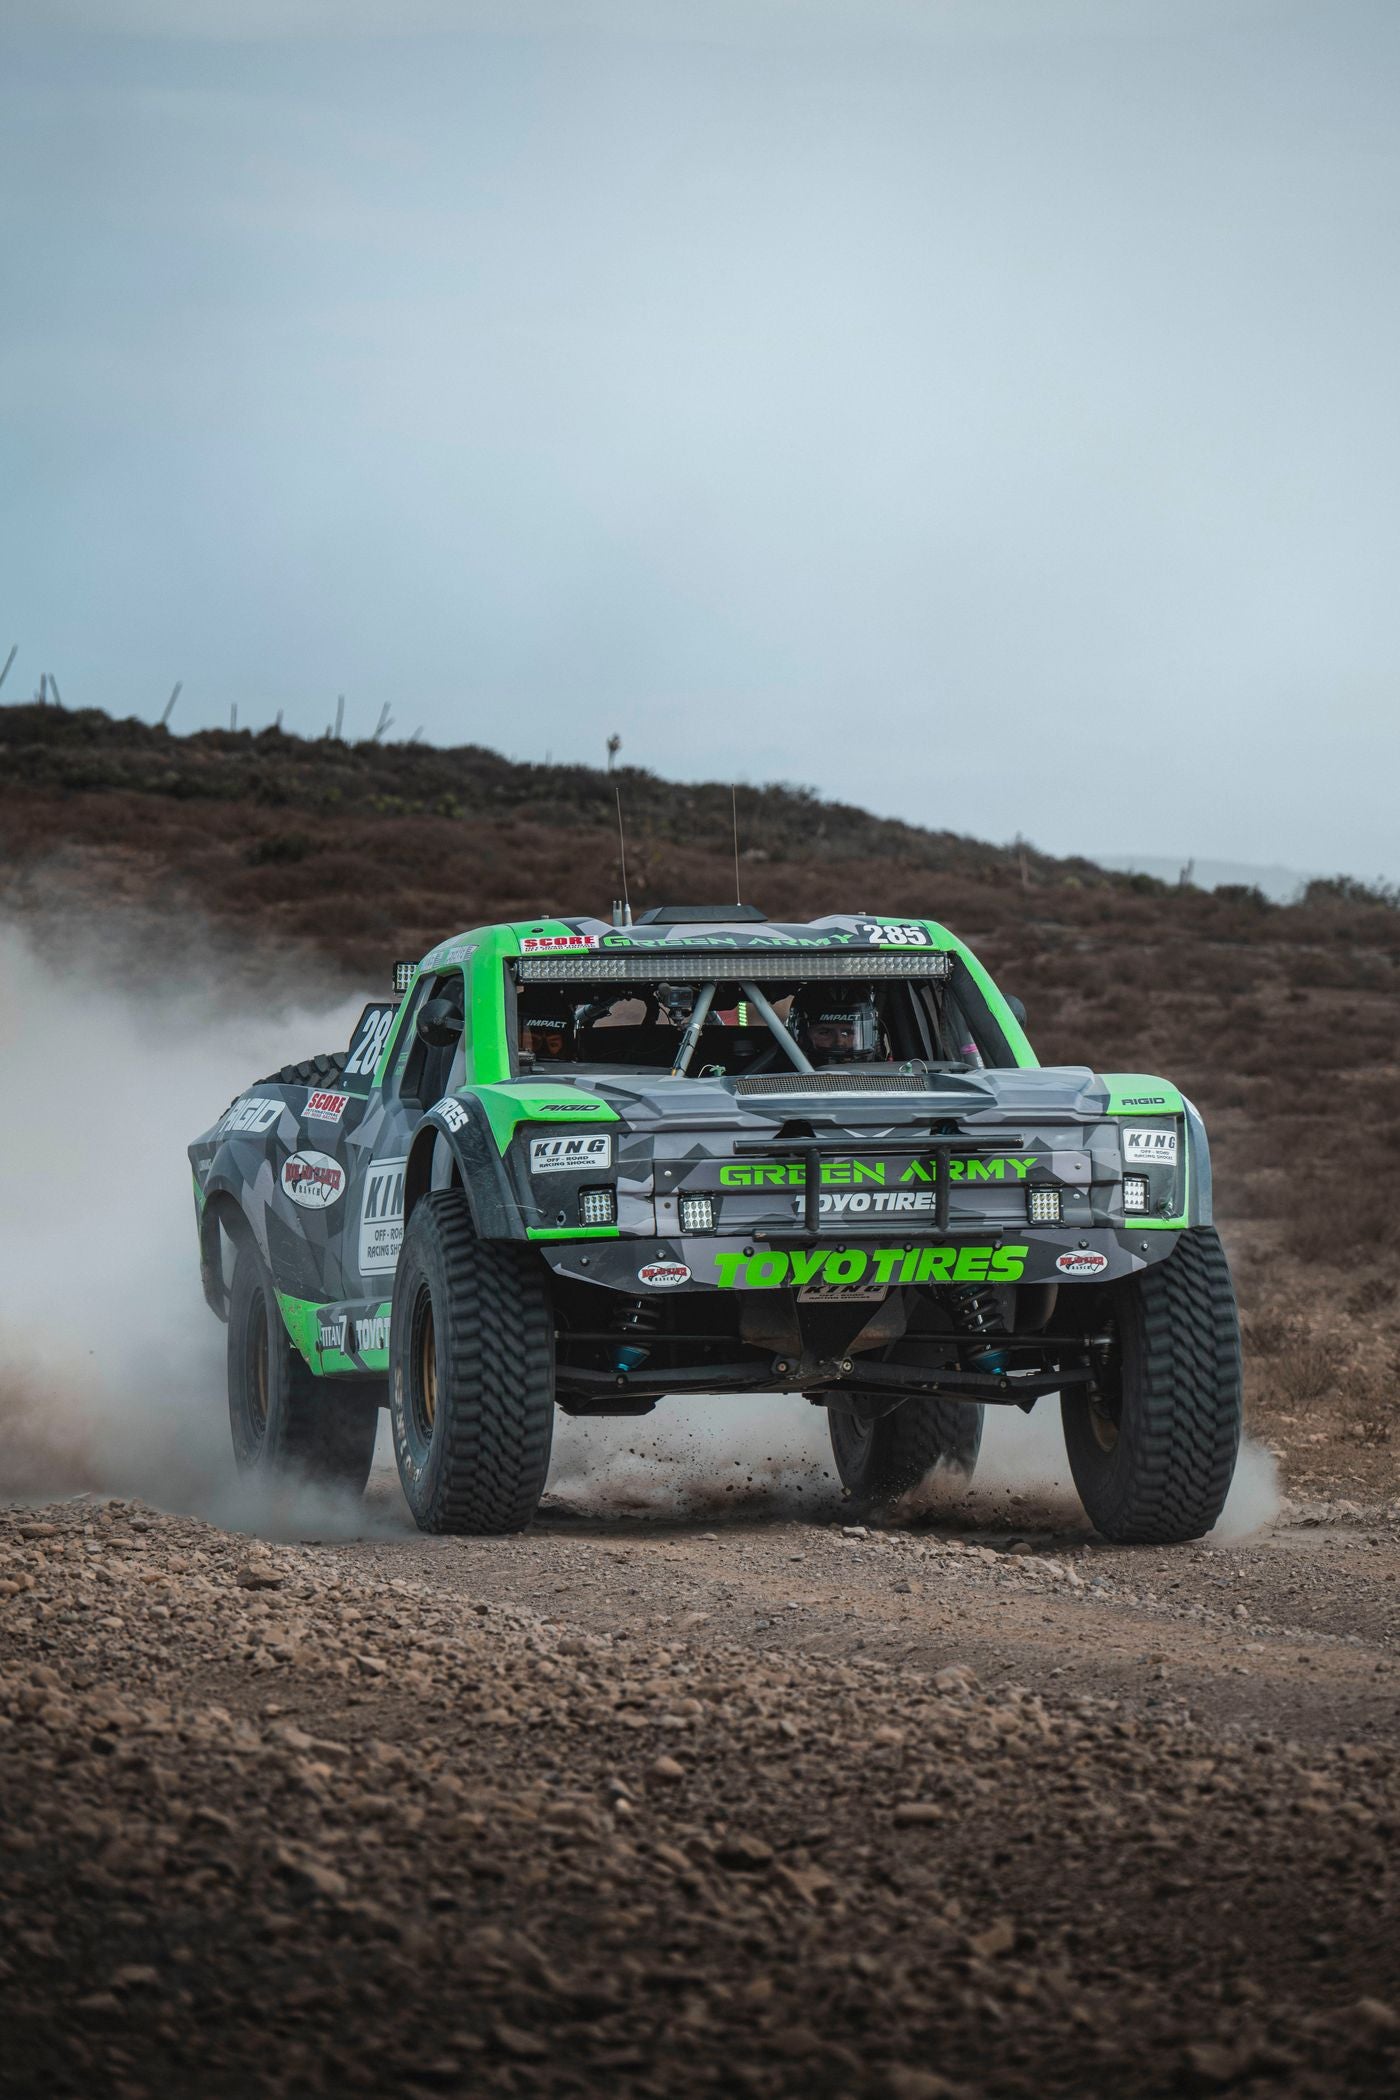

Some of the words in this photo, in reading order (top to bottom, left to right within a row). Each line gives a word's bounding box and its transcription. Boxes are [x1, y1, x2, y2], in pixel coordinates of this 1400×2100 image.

[524, 936, 595, 947] SCORE
[603, 936, 737, 947] GREEN
[749, 934, 853, 946] ARMY
[863, 925, 927, 945] 285
[527, 1019, 567, 1029] IMPACT
[308, 1093, 346, 1113] SCORE
[539, 1104, 600, 1112] RIGID
[1121, 1097, 1166, 1106] RIGID
[427, 1097, 469, 1133] IRES
[534, 1139, 606, 1157] KING
[1128, 1134, 1176, 1149] KING
[719, 1160, 885, 1186] GREEN
[899, 1158, 1039, 1182] ARMY
[374, 1229, 386, 1241] OFF
[367, 1245, 389, 1258] RACING
